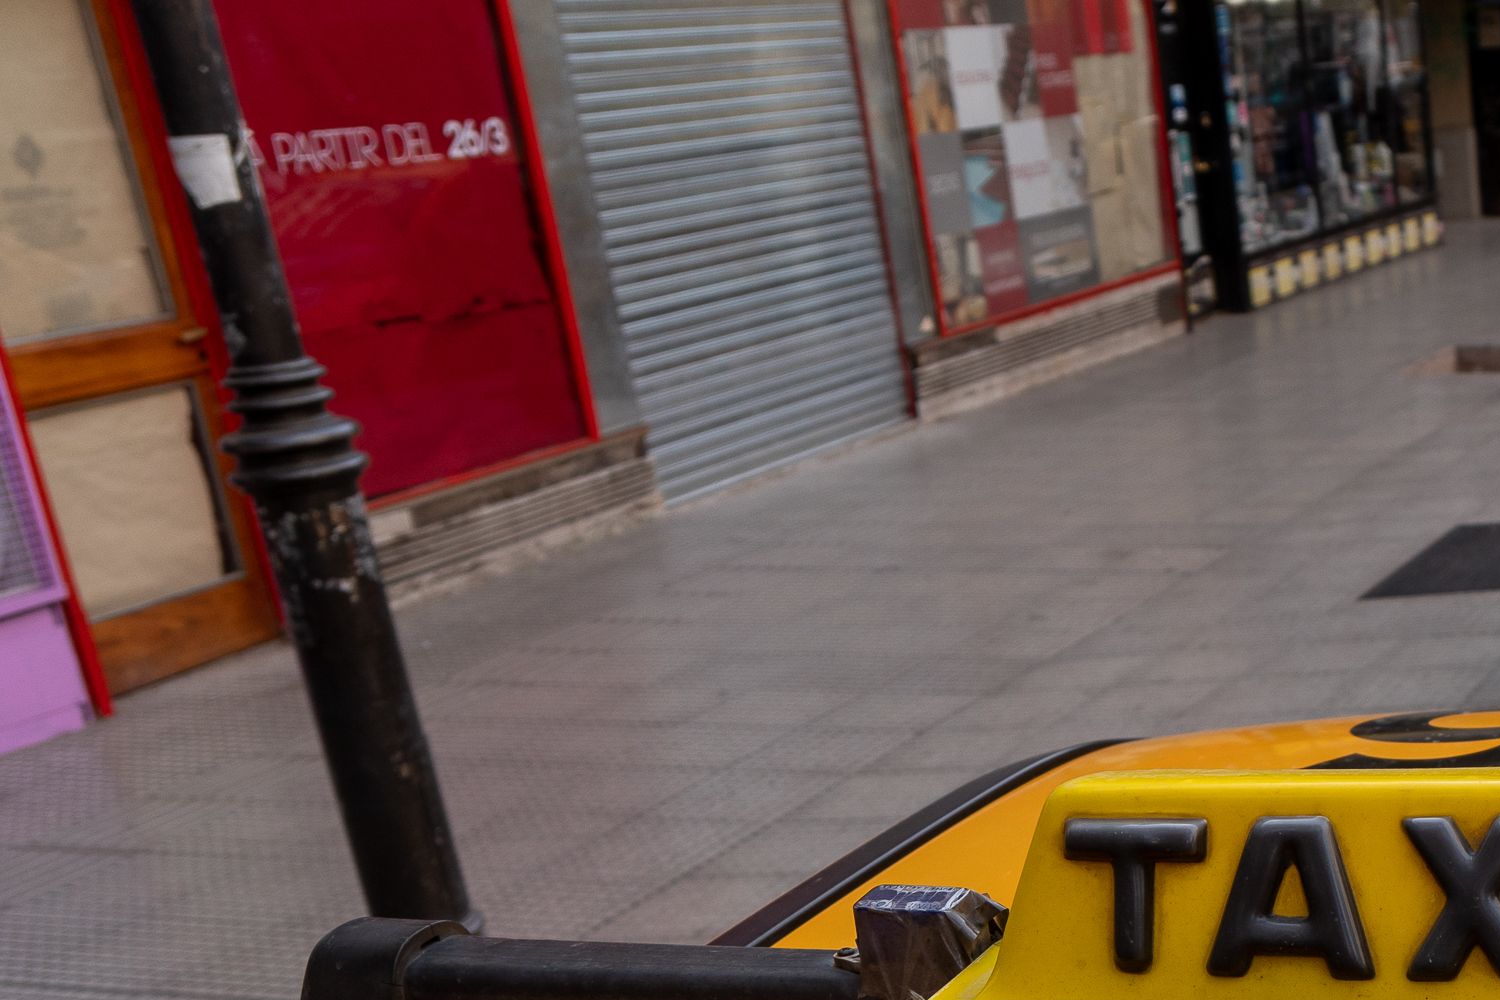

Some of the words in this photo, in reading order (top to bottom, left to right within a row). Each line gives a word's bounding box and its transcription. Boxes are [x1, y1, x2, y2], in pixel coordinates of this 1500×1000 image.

[270, 125, 382, 176] PARTIR
[381, 122, 443, 166] DEL
[442, 116, 510, 159] 26/3
